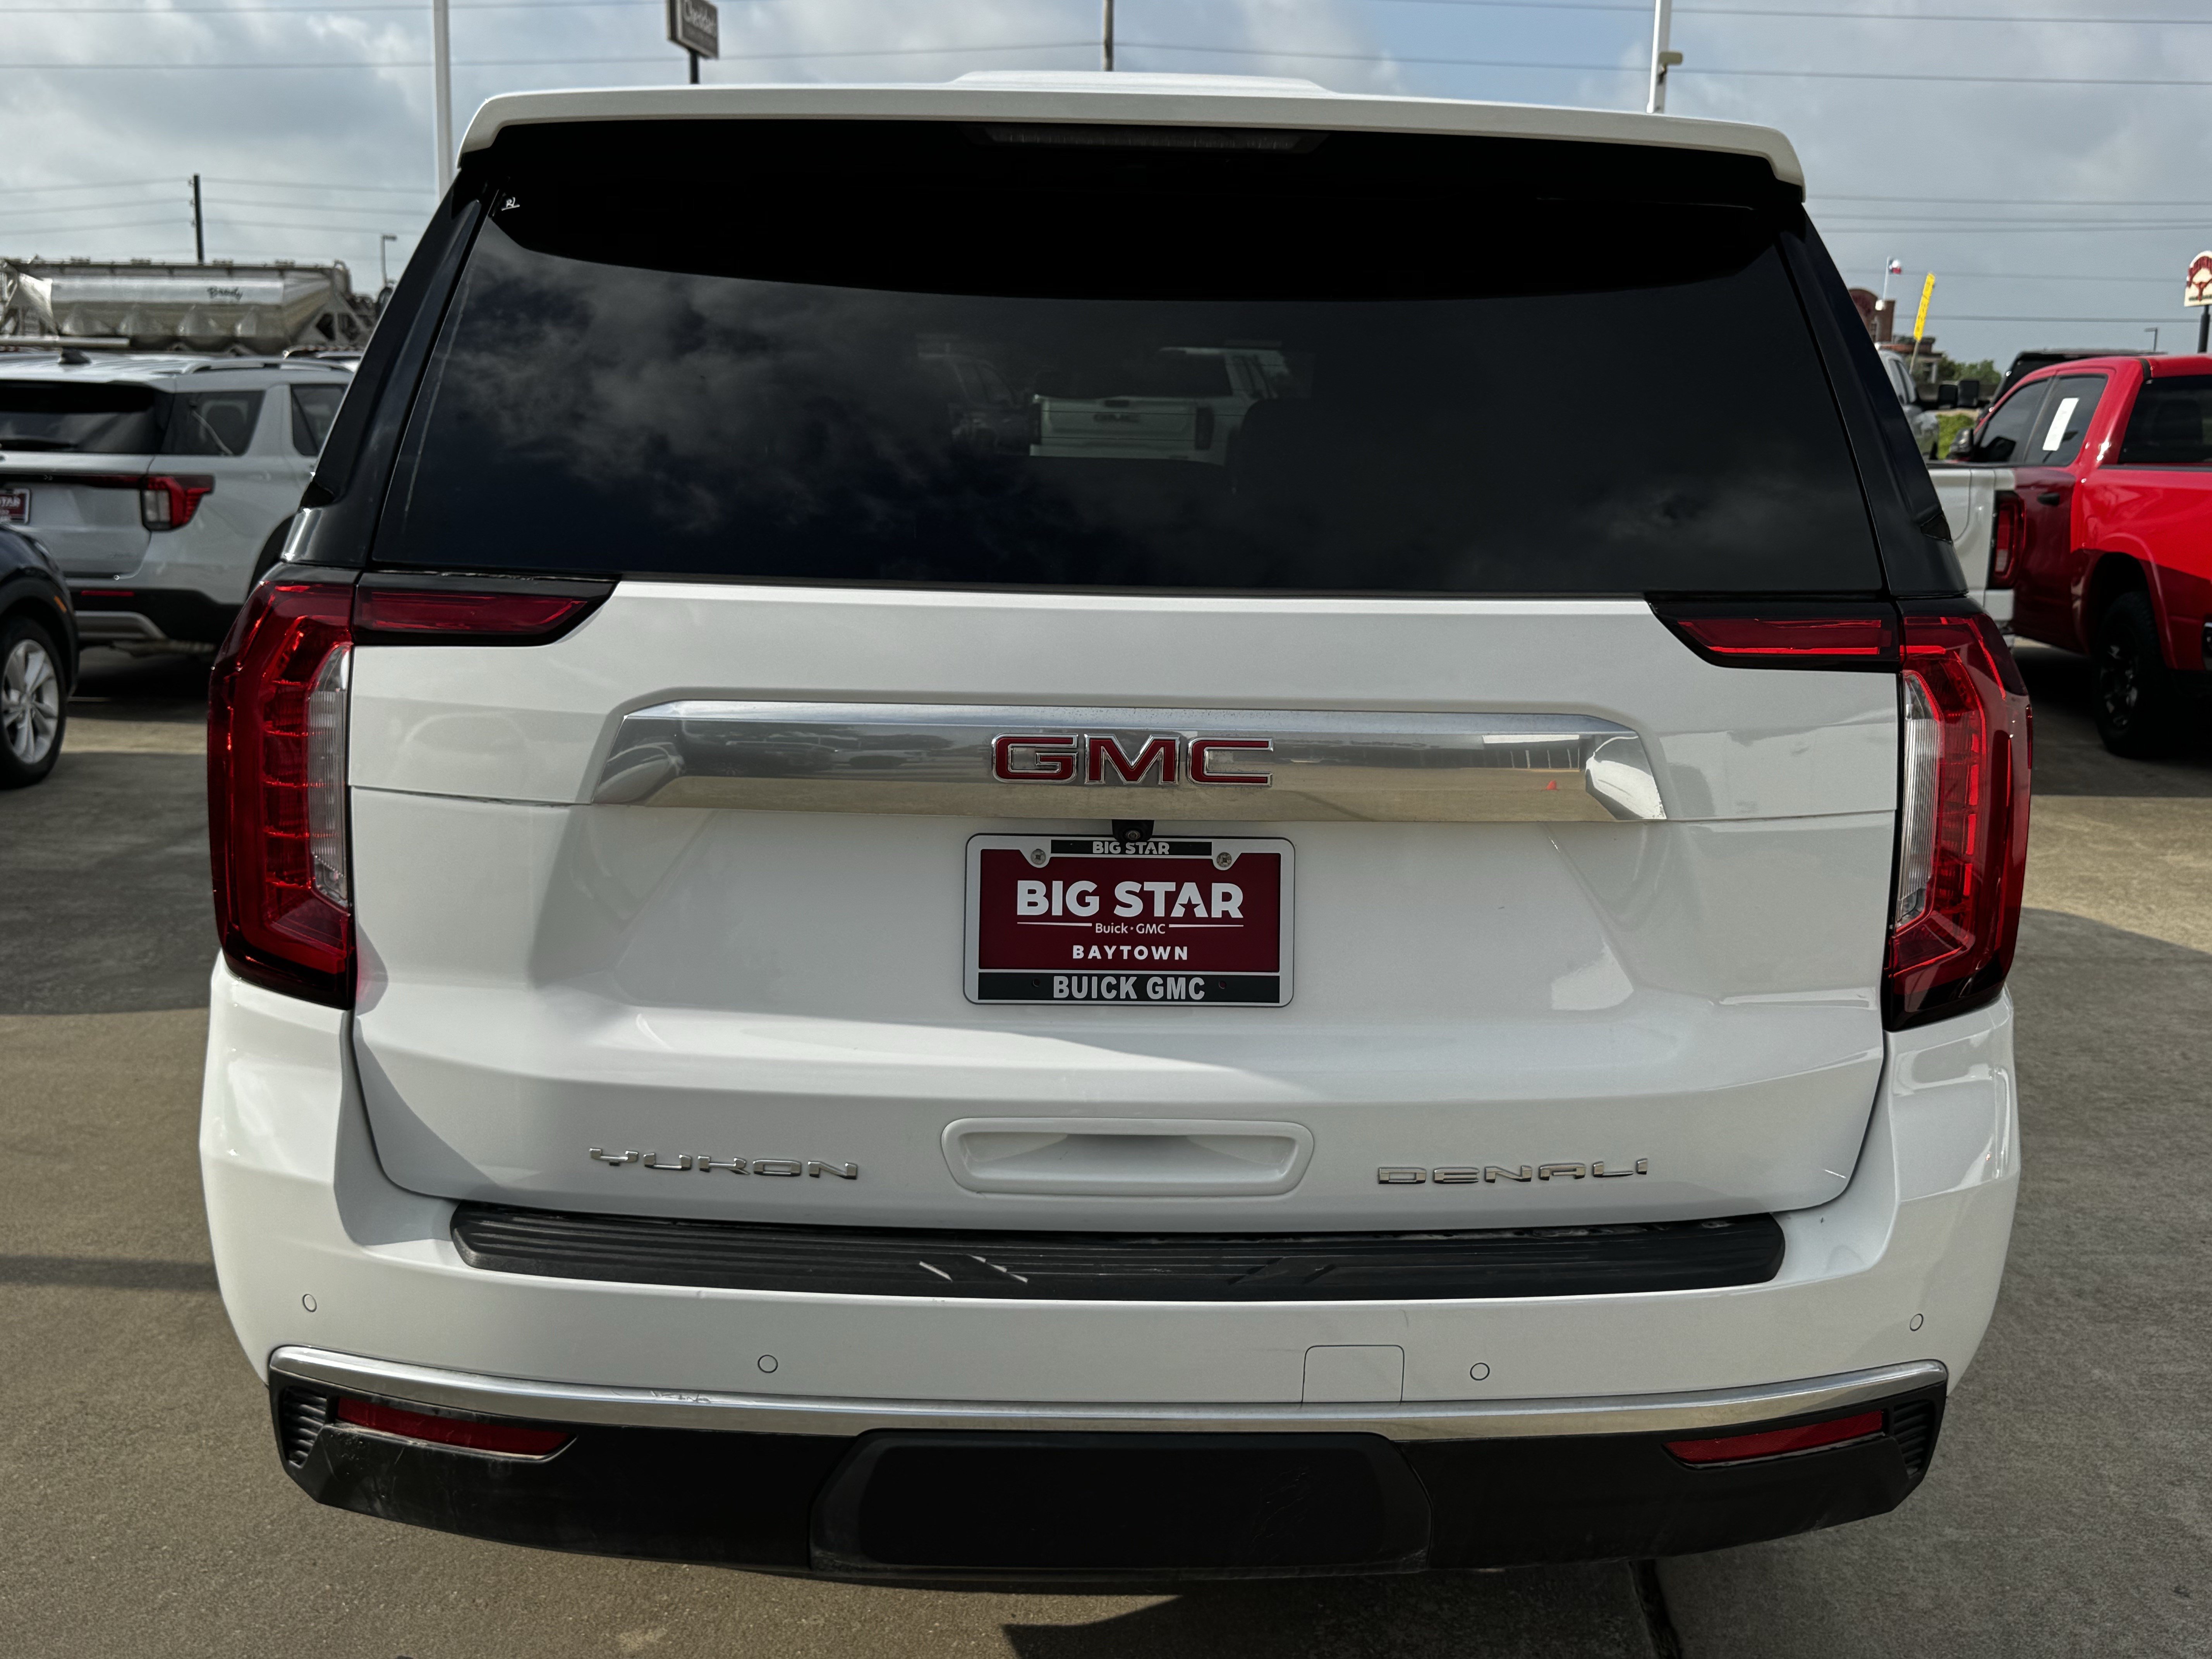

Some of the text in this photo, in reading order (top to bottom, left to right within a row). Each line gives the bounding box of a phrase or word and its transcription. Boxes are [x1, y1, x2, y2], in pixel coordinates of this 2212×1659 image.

[992, 733, 1274, 787] GMC
[1093, 841, 1170, 855] BIG STAR
[1017, 880, 1244, 918] BIG STAR
[1095, 922, 1165, 934] Buick GMC
[1073, 945, 1188, 960] BAYTOWN
[1053, 975, 1205, 1001] BUICK GMC
[589, 1147, 858, 1180] YUKON
[1377, 1158, 1648, 1185] DENALI
